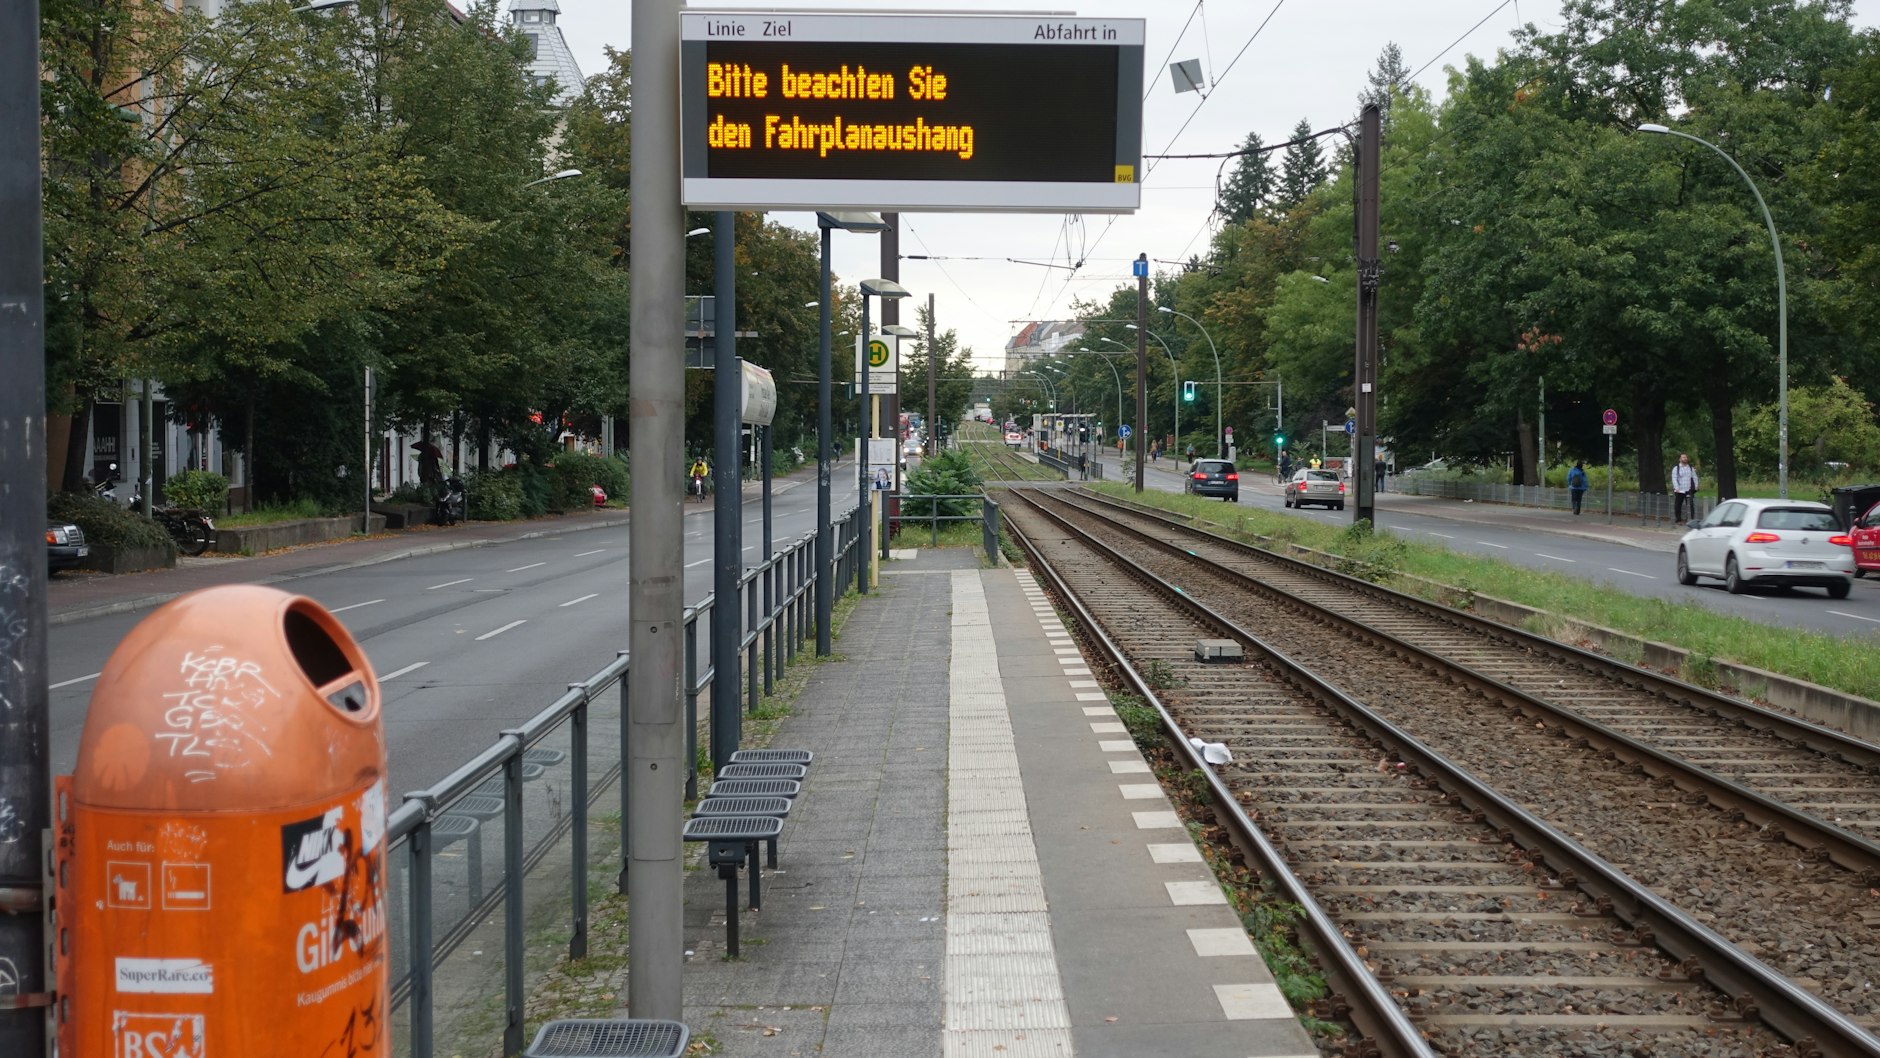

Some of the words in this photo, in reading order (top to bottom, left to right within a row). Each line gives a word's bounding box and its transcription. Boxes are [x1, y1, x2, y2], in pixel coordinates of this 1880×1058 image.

[708, 20, 745, 36] Linie
[763, 20, 791, 36] Ziel
[1034, 24, 1097, 40] Abfahrt
[1103, 24, 1117, 40] in
[707, 62, 768, 97] Bitte
[781, 64, 895, 99] beachten
[908, 65, 948, 100] Sie
[708, 114, 751, 148] den
[765, 115, 974, 159] Fahrplanaushang
[1117, 174, 1132, 183] BVG
[869, 346, 882, 361] H
[107, 840, 133, 852] Auch
[136, 841, 155, 853] für:
[120, 967, 209, 983] SuperRare.co
